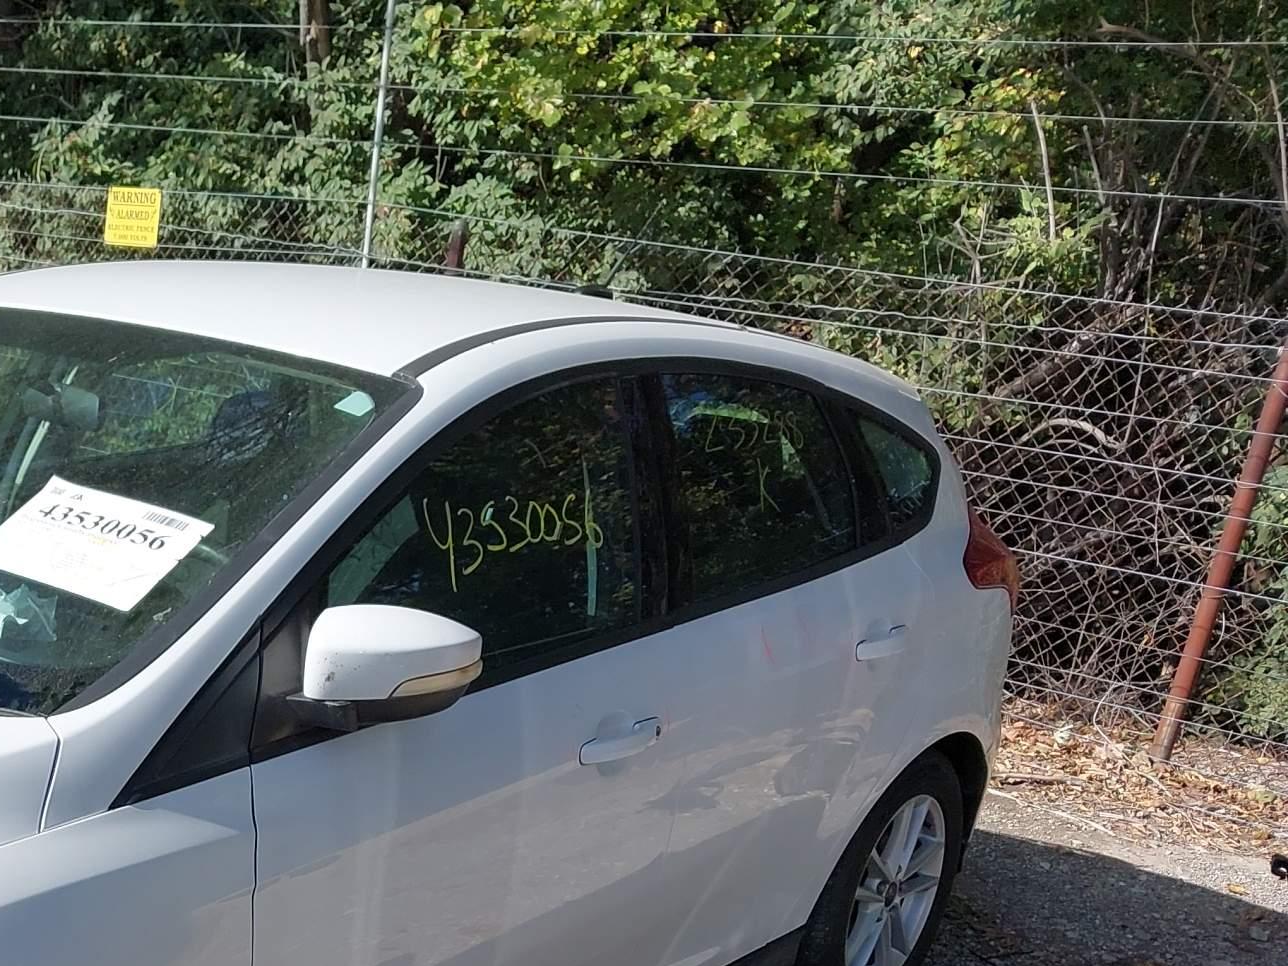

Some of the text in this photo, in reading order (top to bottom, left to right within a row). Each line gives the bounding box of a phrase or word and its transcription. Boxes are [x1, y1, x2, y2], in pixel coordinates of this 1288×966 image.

[113, 190, 157, 205] WARNING
[116, 208, 150, 220] ALARMED
[39, 504, 172, 550] 43530056
[423, 490, 604, 593] 43530056
